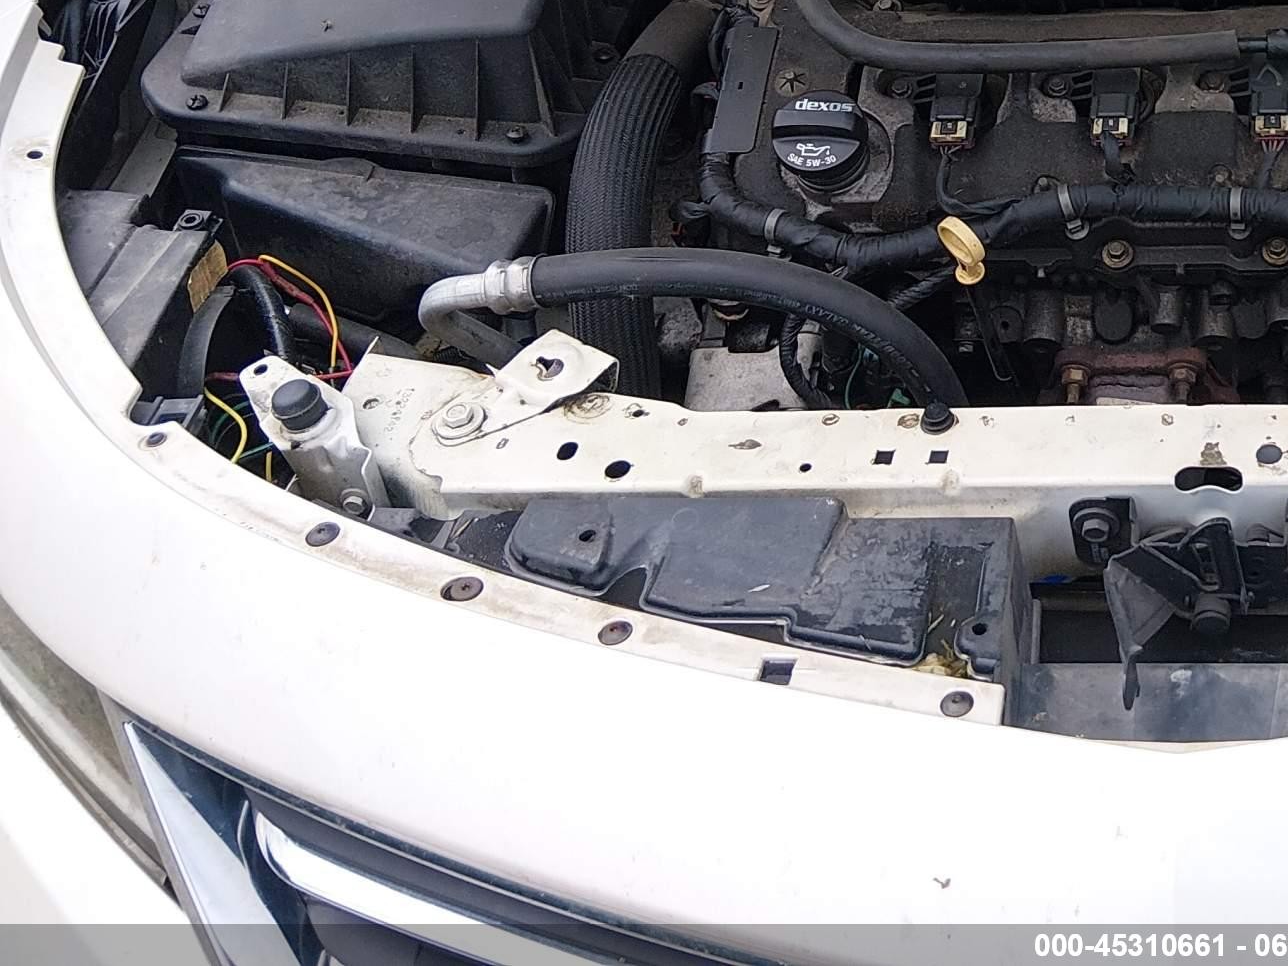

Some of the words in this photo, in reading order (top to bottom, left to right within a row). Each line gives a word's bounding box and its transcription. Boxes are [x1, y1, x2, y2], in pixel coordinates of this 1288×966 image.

[795, 98, 856, 112] dexos
[787, 153, 804, 166] SAE
[806, 155, 837, 167] 5W-30
